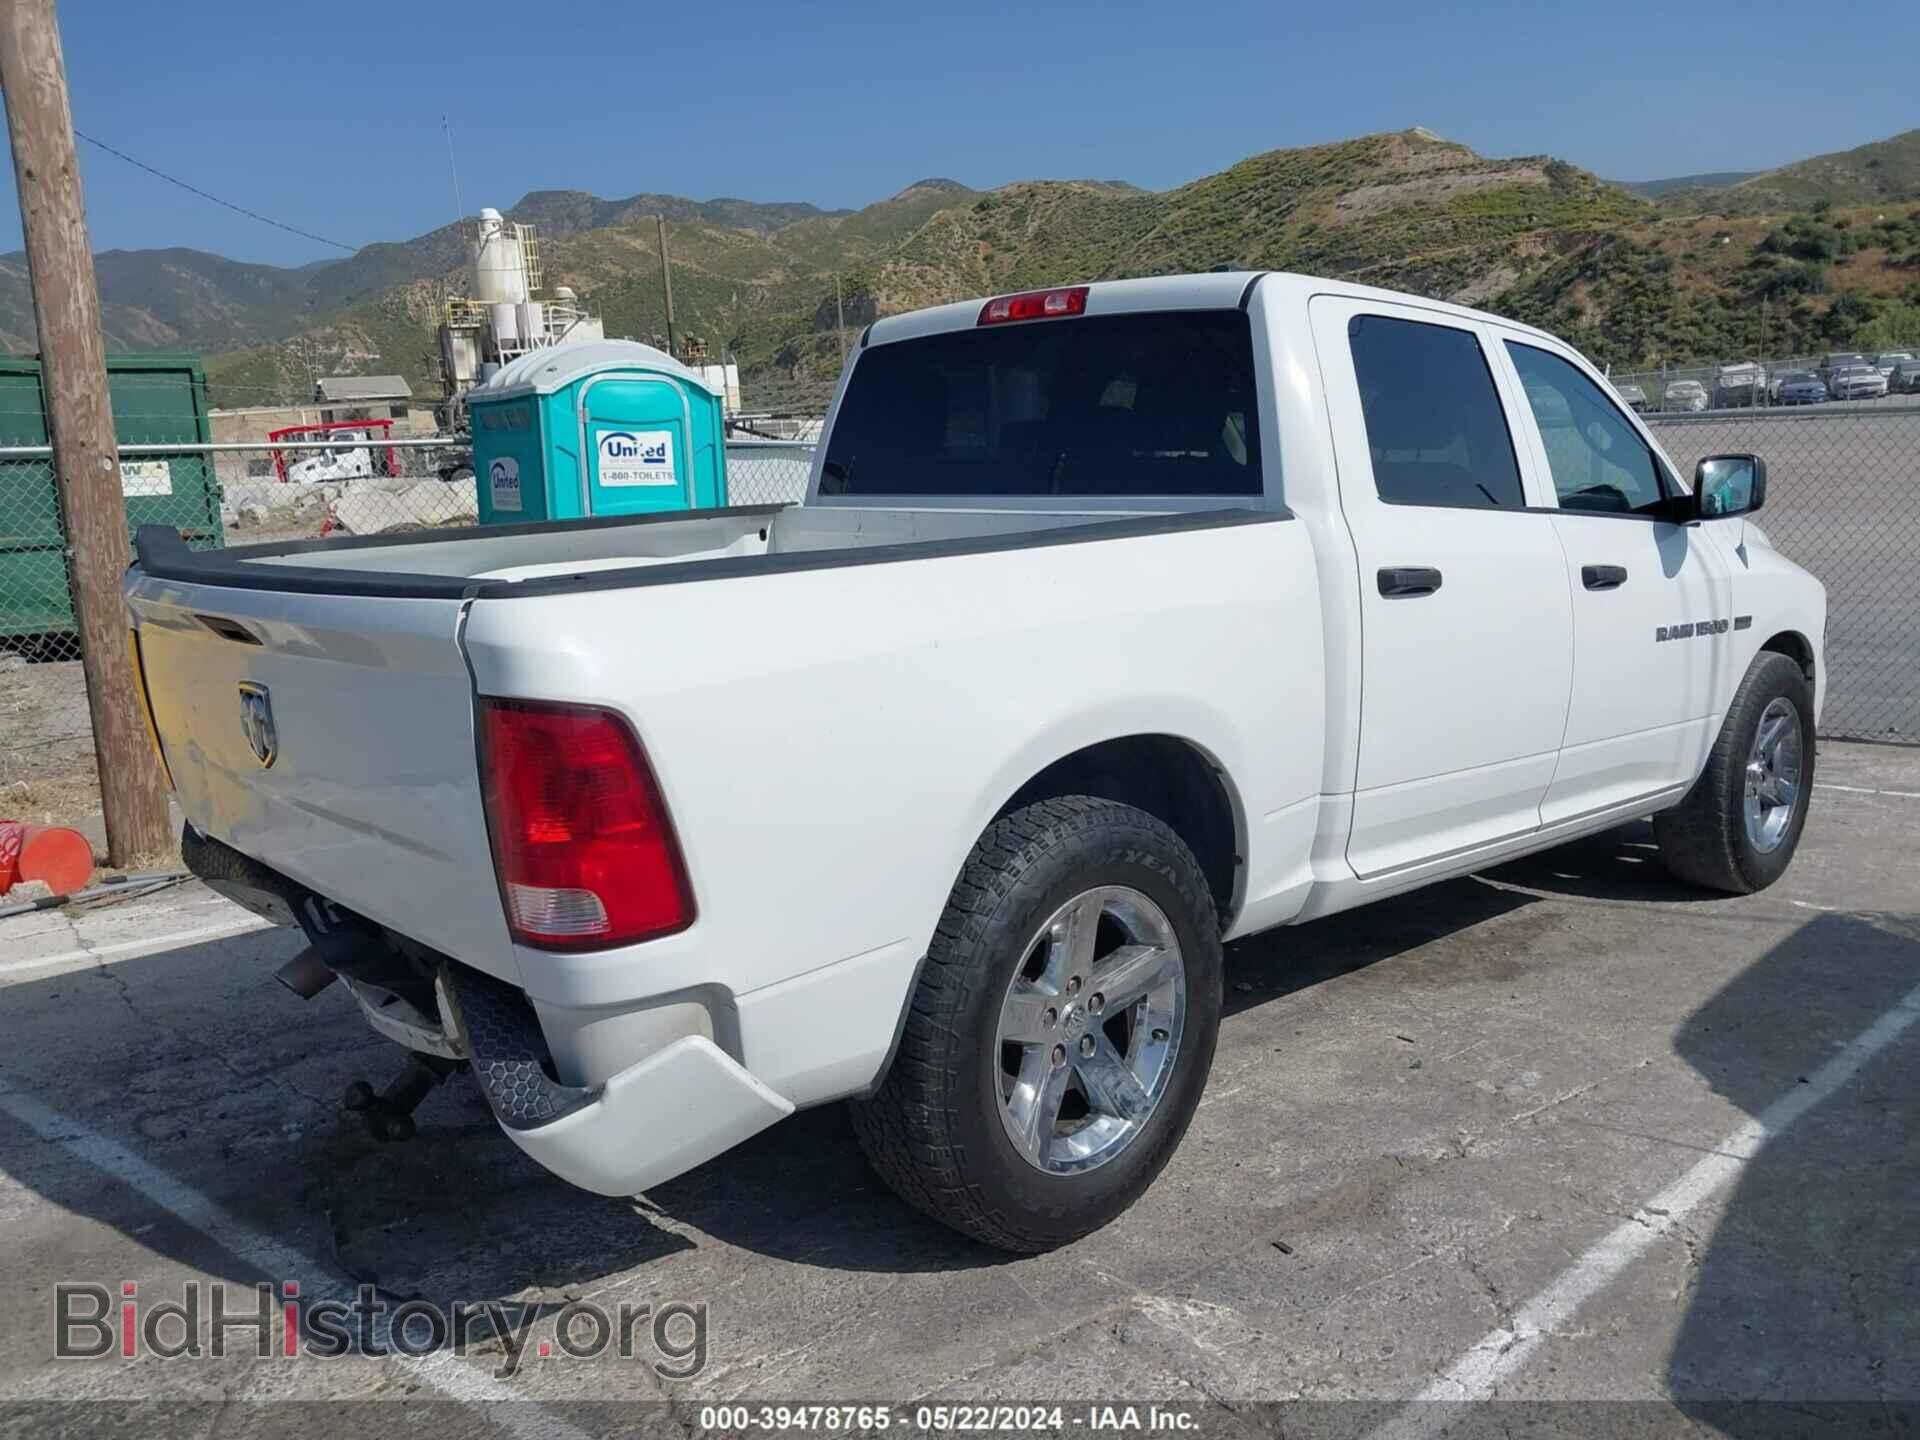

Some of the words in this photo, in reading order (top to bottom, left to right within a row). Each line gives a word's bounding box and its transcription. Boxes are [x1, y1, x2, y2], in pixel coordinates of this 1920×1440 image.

[602, 471, 673, 481] 1-800-TOILETS
[1656, 624, 1694, 642] RAM
[1695, 619, 1728, 636] 1500
